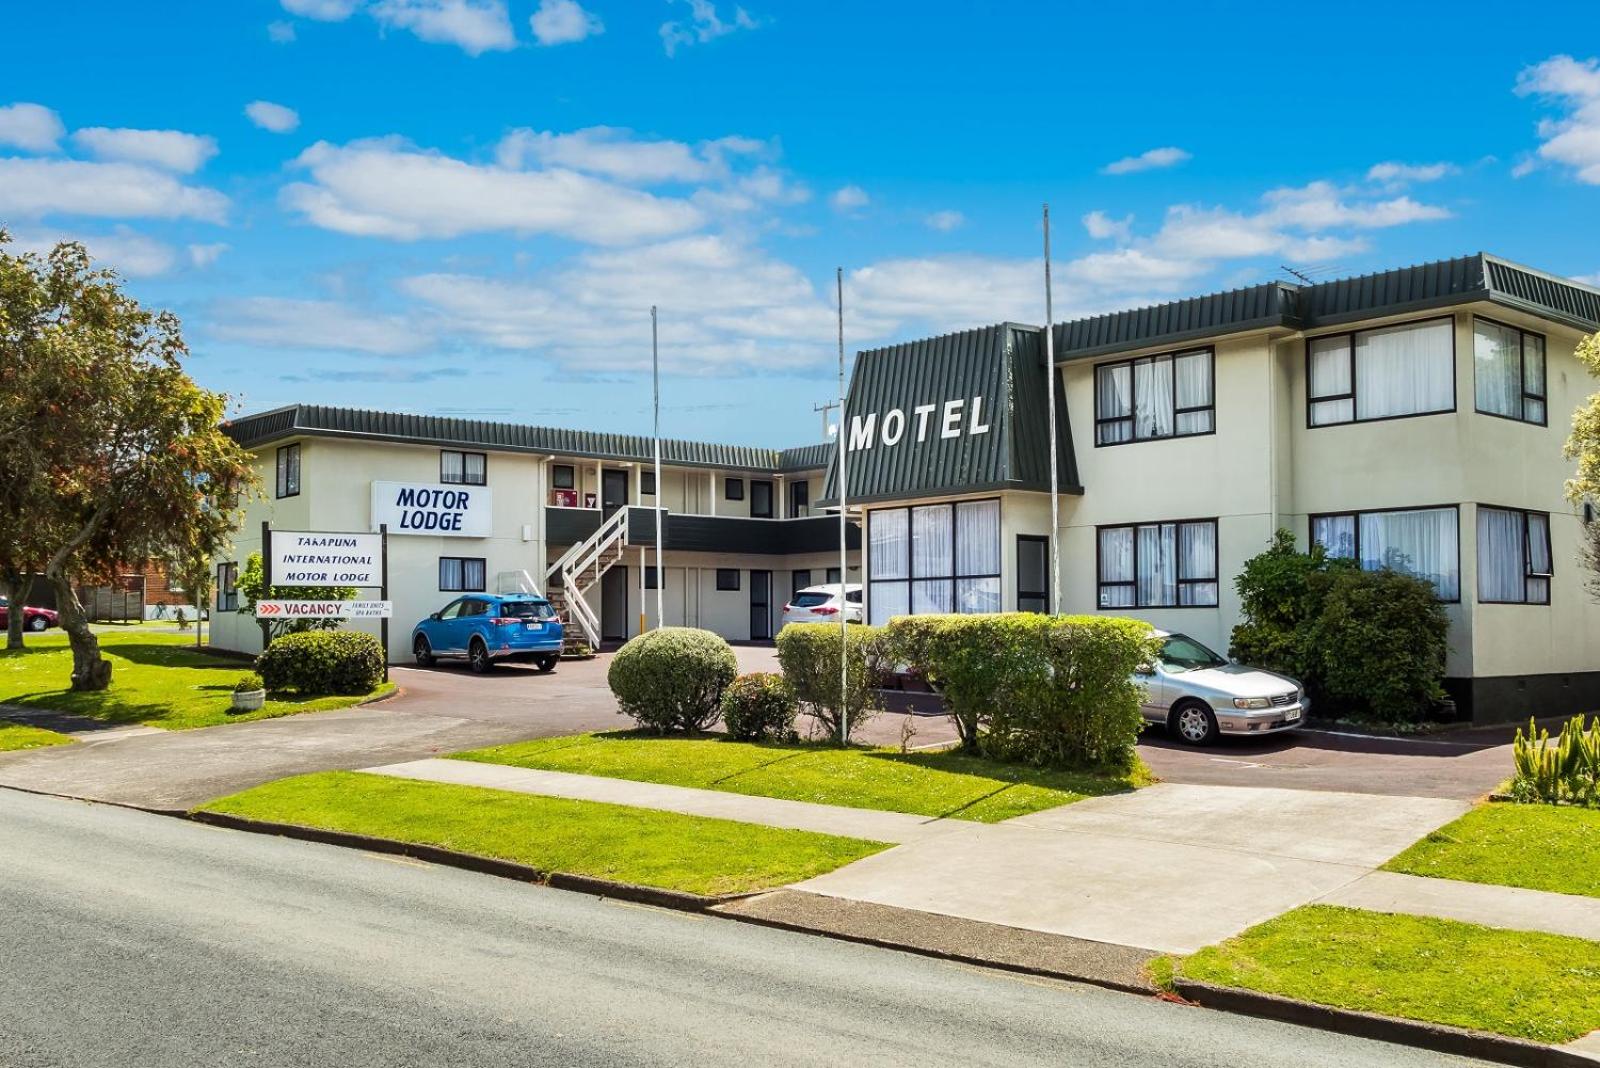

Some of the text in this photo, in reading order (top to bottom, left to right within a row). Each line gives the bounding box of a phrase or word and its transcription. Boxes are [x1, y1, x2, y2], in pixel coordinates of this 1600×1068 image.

[849, 396, 989, 451] MOTEL
[396, 487, 469, 510] MOTOR
[400, 510, 463, 531] LODGE
[298, 537, 357, 547] TAKAPUNA
[283, 554, 372, 565] INTERNATIONAL
[286, 572, 370, 582] MOTOR LODGE
[284, 603, 342, 615] VACANCY
